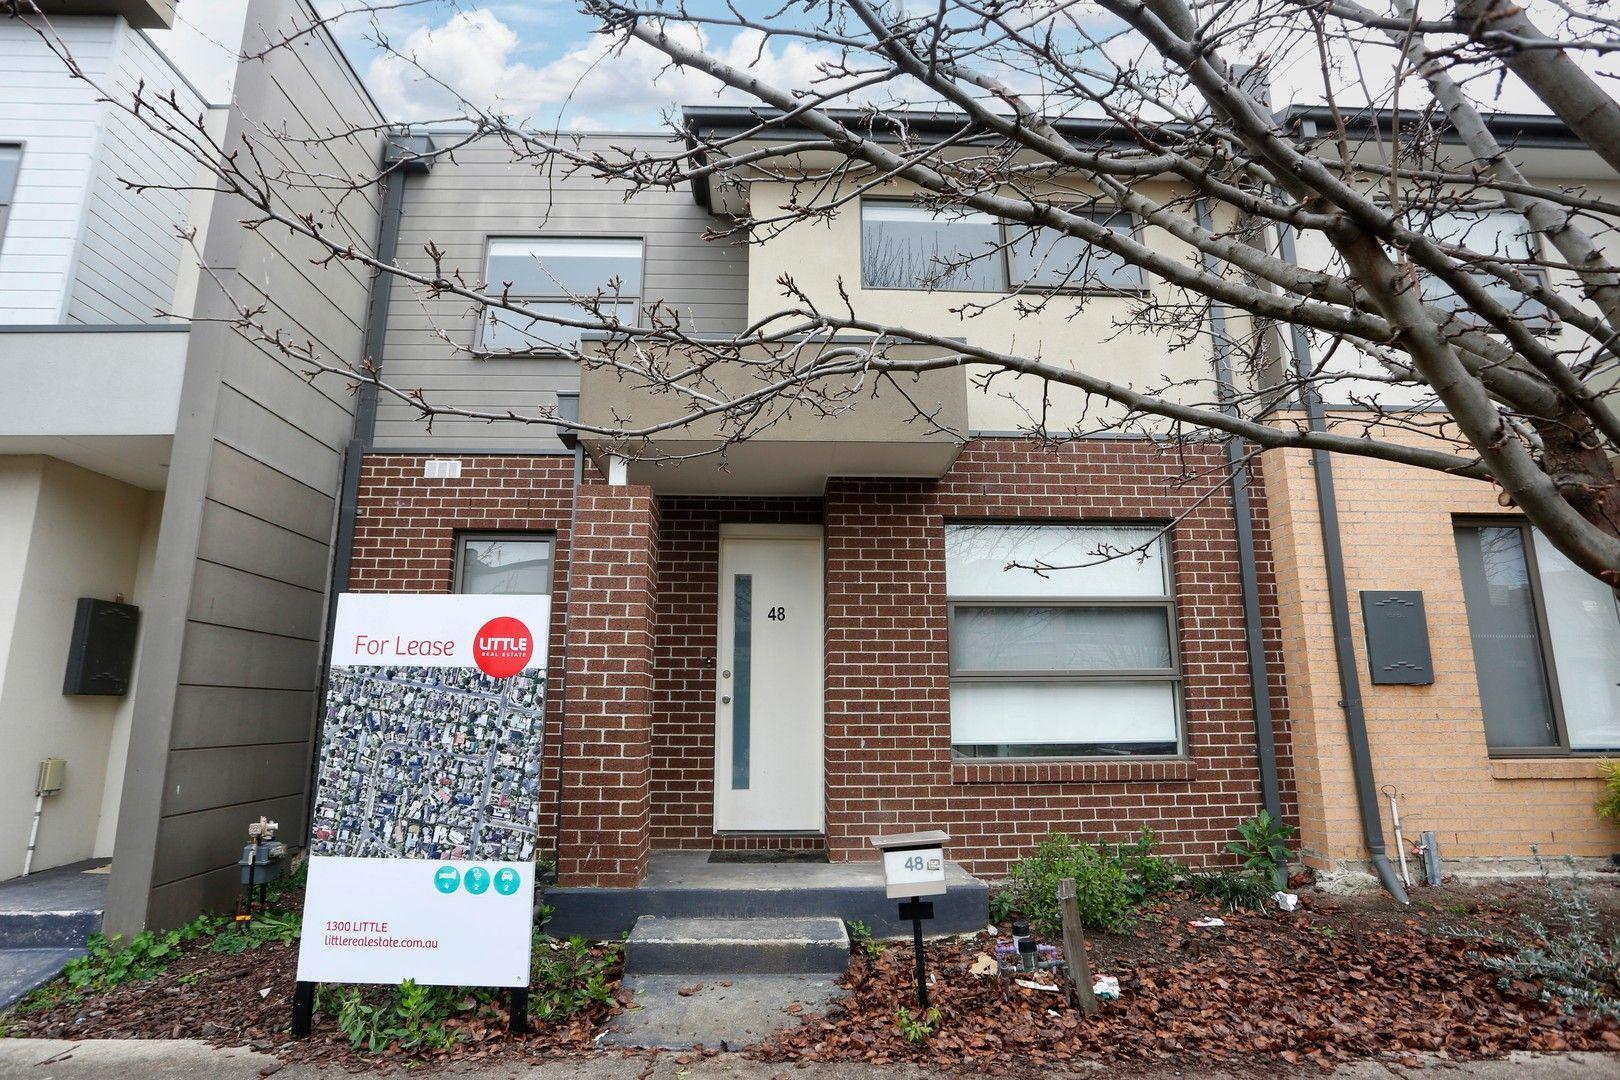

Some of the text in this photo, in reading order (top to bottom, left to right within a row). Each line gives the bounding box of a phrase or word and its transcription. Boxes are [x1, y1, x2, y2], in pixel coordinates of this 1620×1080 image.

[767, 606, 786, 621] 48
[355, 635, 455, 657] For Lease
[479, 637, 528, 651] LITTLE
[904, 856, 924, 871] 48
[326, 921, 388, 933] 1300 LITTLE
[324, 935, 439, 949] littlerealestate.com.au
